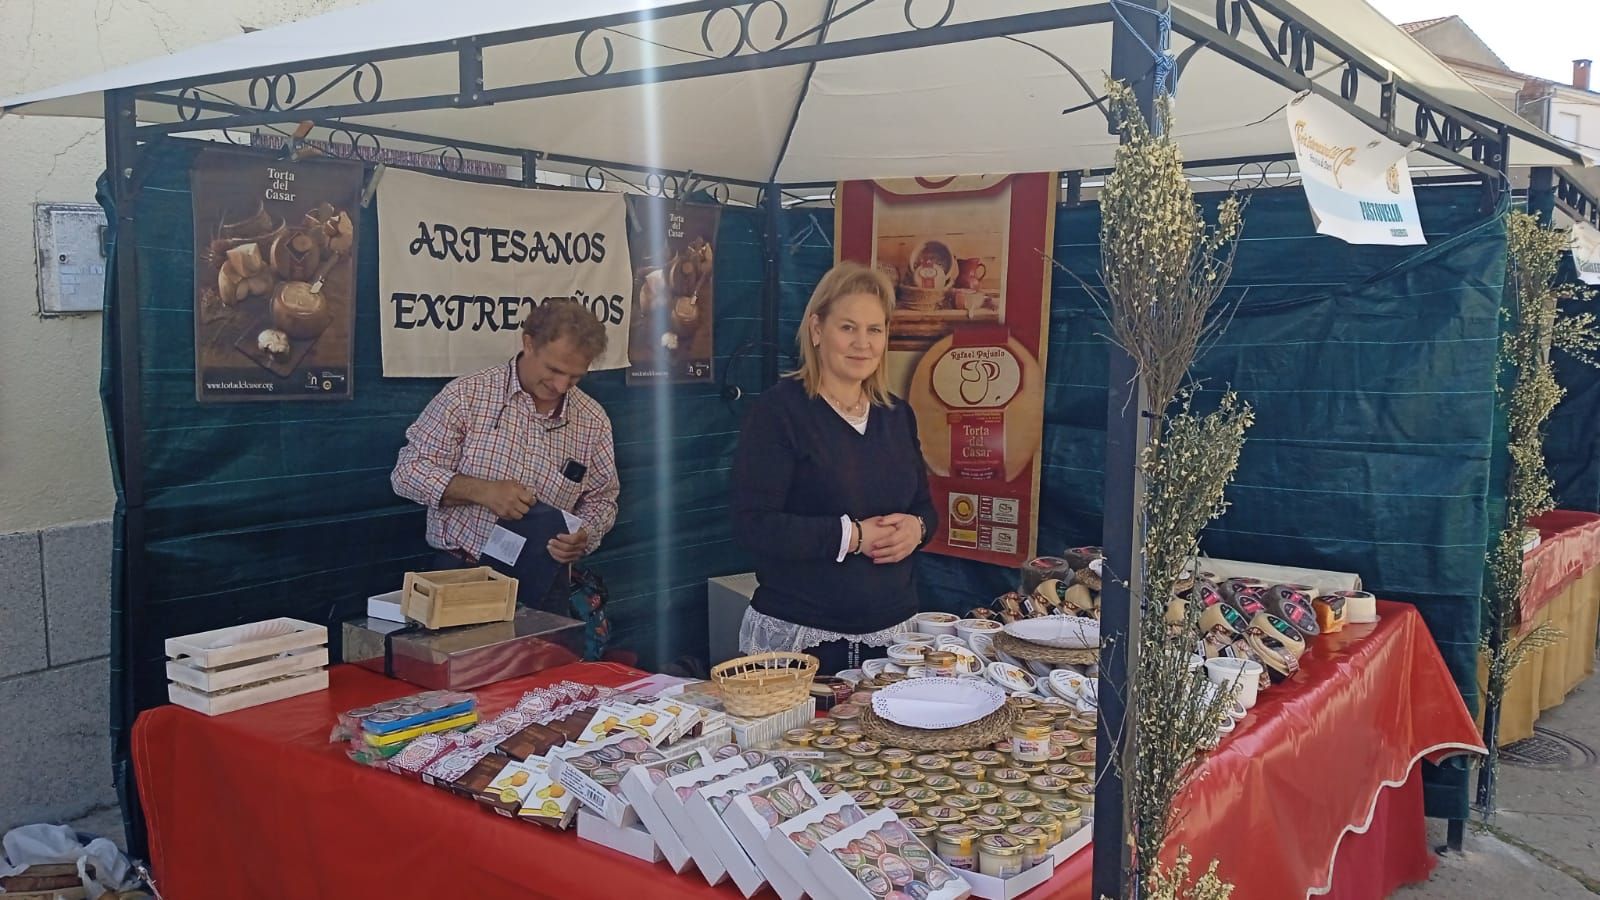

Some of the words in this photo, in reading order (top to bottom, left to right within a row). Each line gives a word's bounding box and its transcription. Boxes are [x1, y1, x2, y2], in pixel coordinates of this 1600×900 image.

[267, 167, 295, 181] Torta
[272, 180, 288, 190] del
[265, 188, 296, 201] Casar
[409, 221, 606, 265] ARTESANOS
[391, 290, 624, 333] EXTREOS
[950, 351, 975, 360] Rafael
[963, 425, 990, 436] Torta
[969, 436, 984, 447] del
[962, 447, 992, 458] Casar
